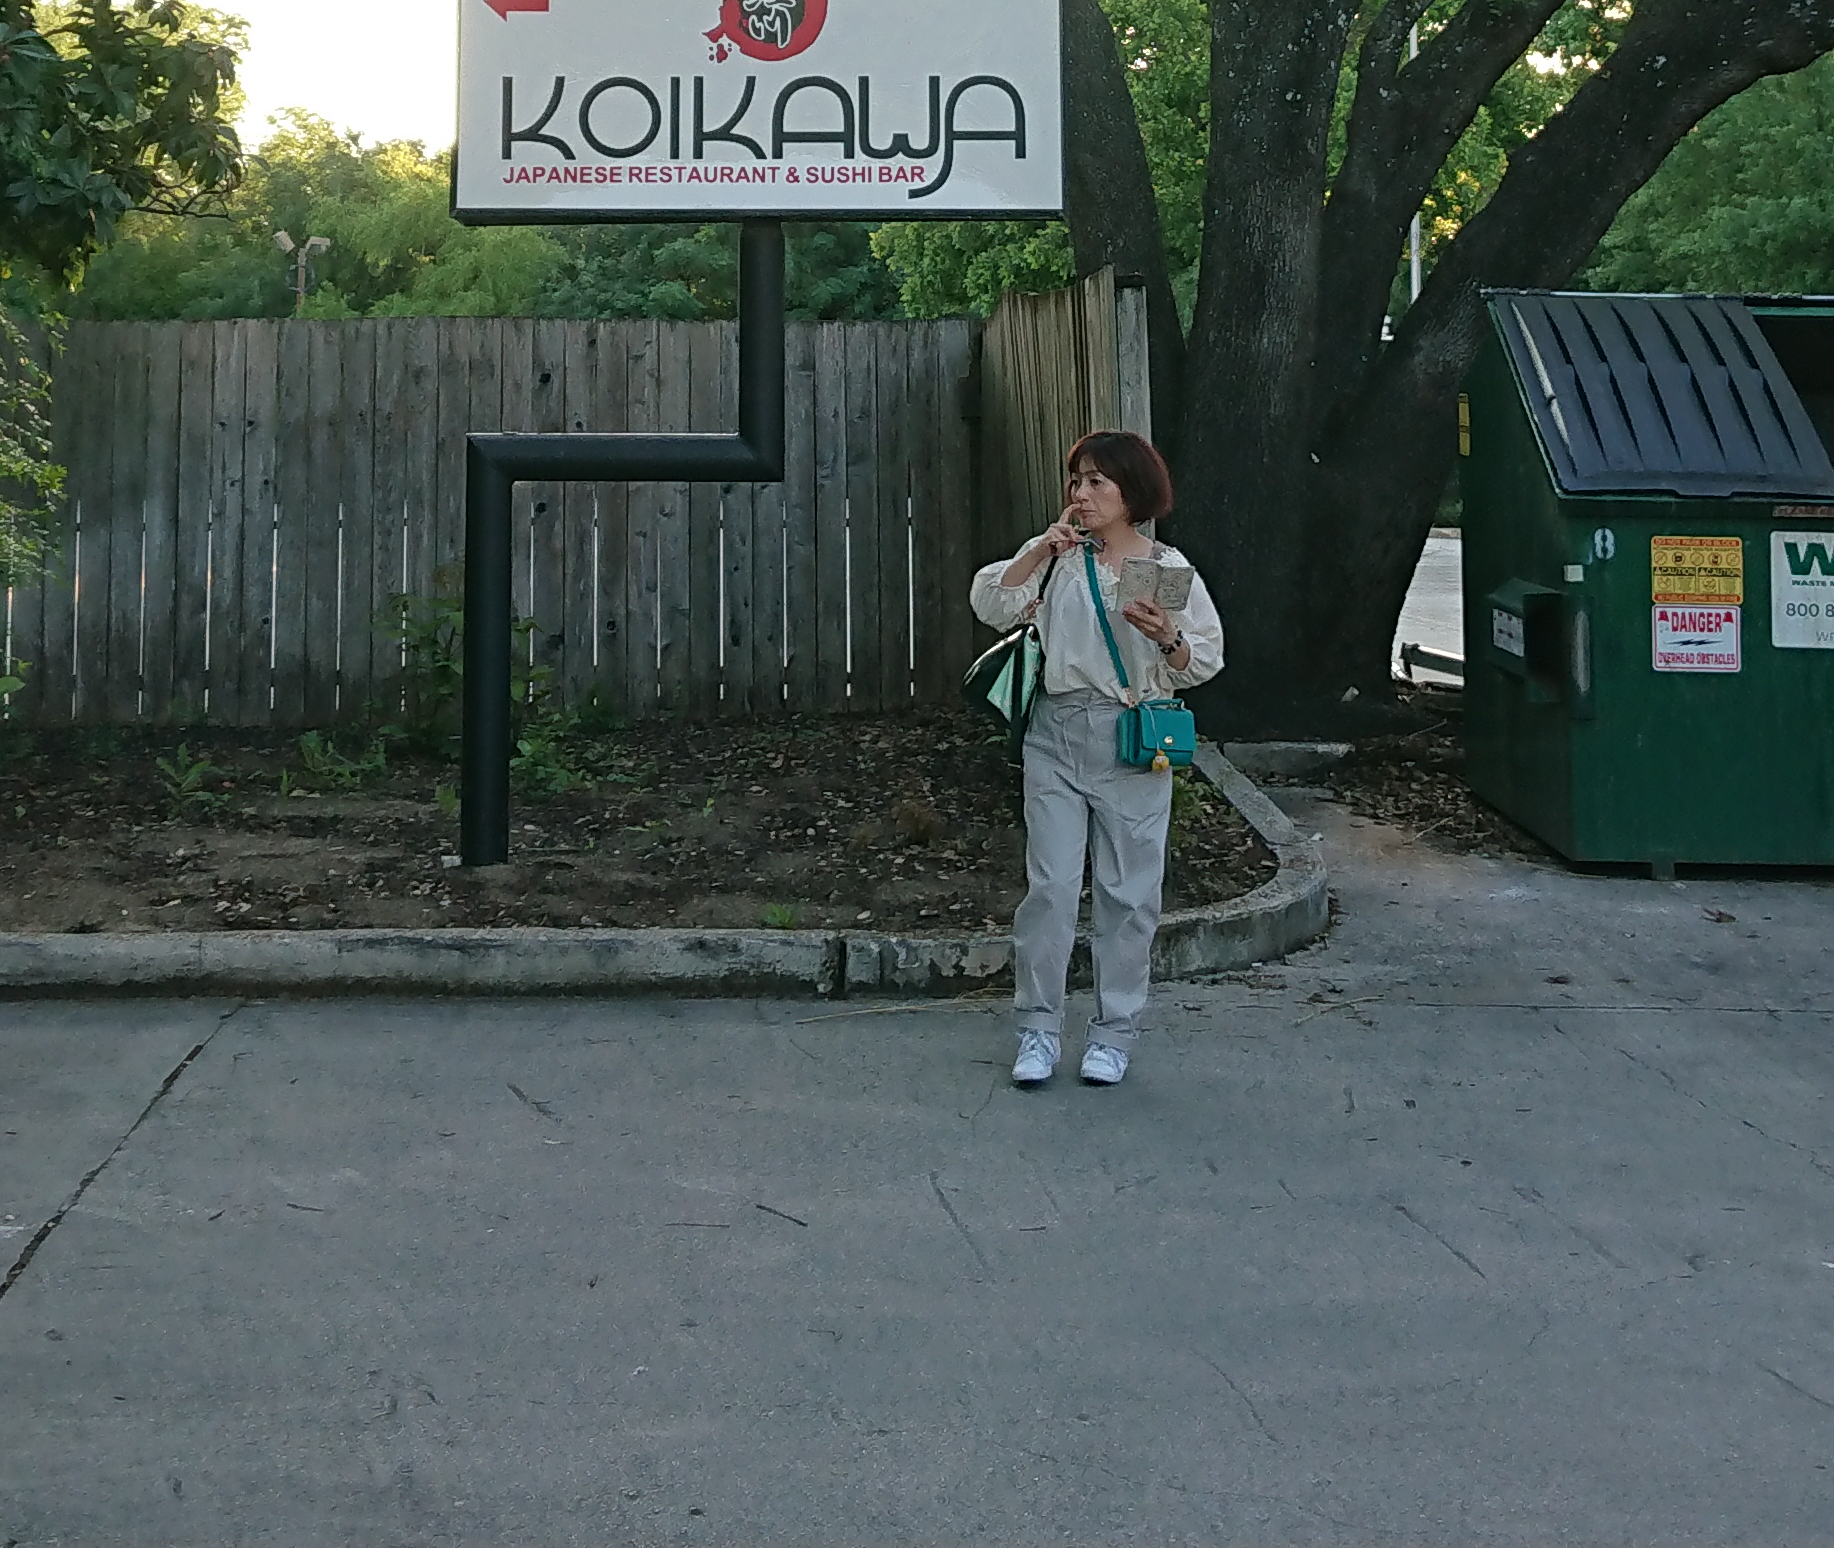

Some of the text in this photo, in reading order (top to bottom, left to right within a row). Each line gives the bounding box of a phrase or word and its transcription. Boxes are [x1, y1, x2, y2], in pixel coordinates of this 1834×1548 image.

[501, 75, 1027, 200] KOIKAWA
[502, 165, 926, 185] JAPANESE RESTAURANT & SUSHI BAR
[1661, 567, 1695, 575] CAUTION
[1706, 568, 1741, 576] CAUTION
[1792, 579, 1827, 587] WASTE
[1786, 603, 1820, 617] 800
[1671, 611, 1722, 633] DANGER
[1658, 652, 1736, 665] OVERHEAD OBSTACLES
